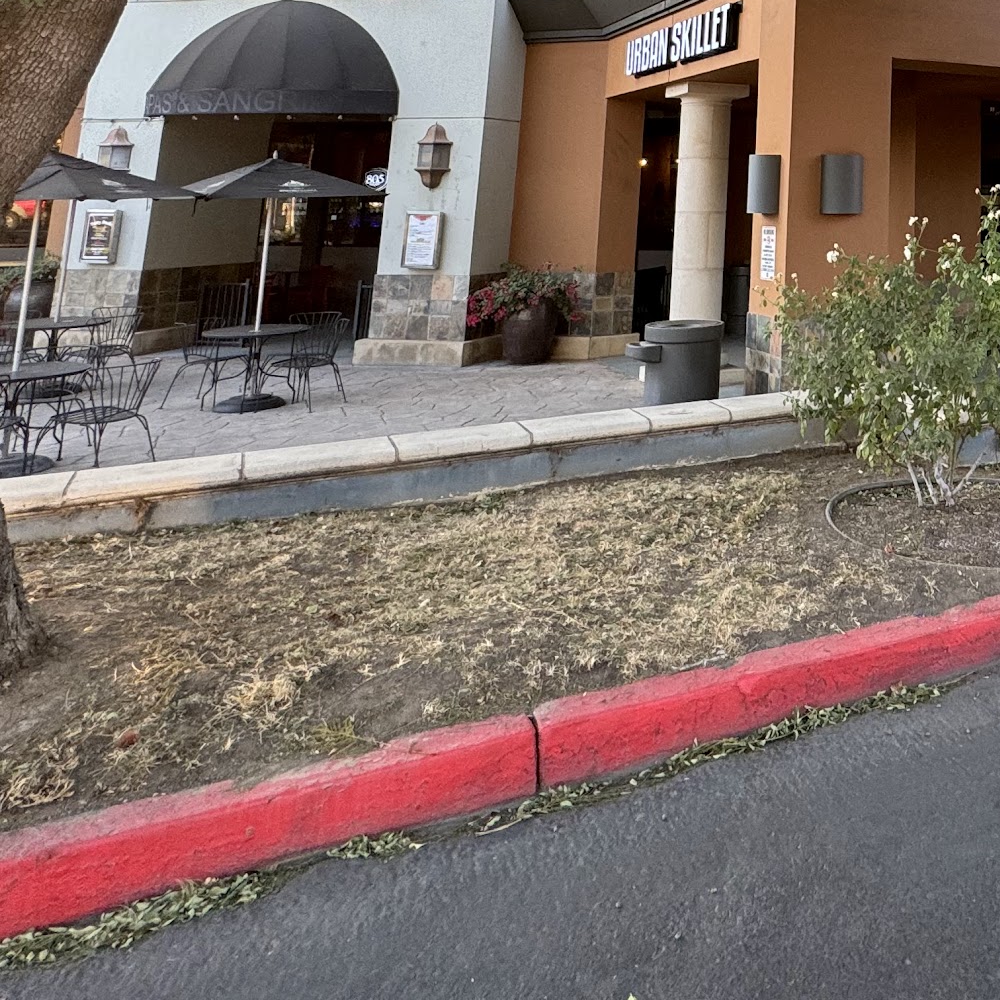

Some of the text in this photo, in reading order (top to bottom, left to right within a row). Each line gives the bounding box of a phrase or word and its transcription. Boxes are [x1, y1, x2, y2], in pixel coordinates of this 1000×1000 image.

[625, 3, 730, 76] URBAN SKILLET
[366, 174, 385, 186] 805
